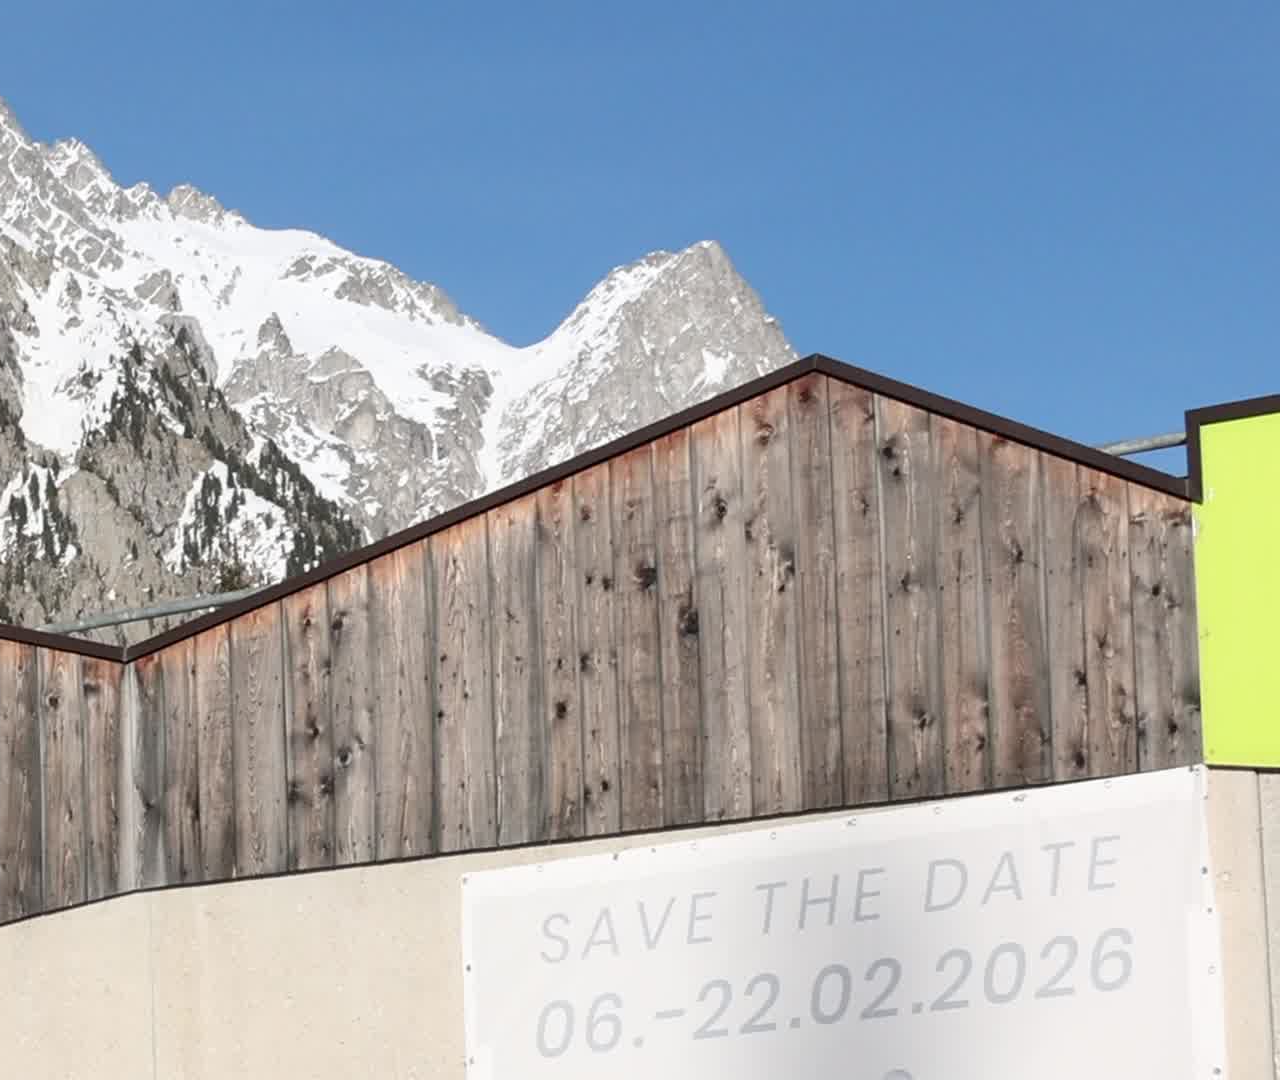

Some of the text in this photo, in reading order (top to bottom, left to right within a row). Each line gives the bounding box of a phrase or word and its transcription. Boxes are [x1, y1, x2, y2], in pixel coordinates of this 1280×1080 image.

[539, 834, 1122, 965] SAVE THE DATE
